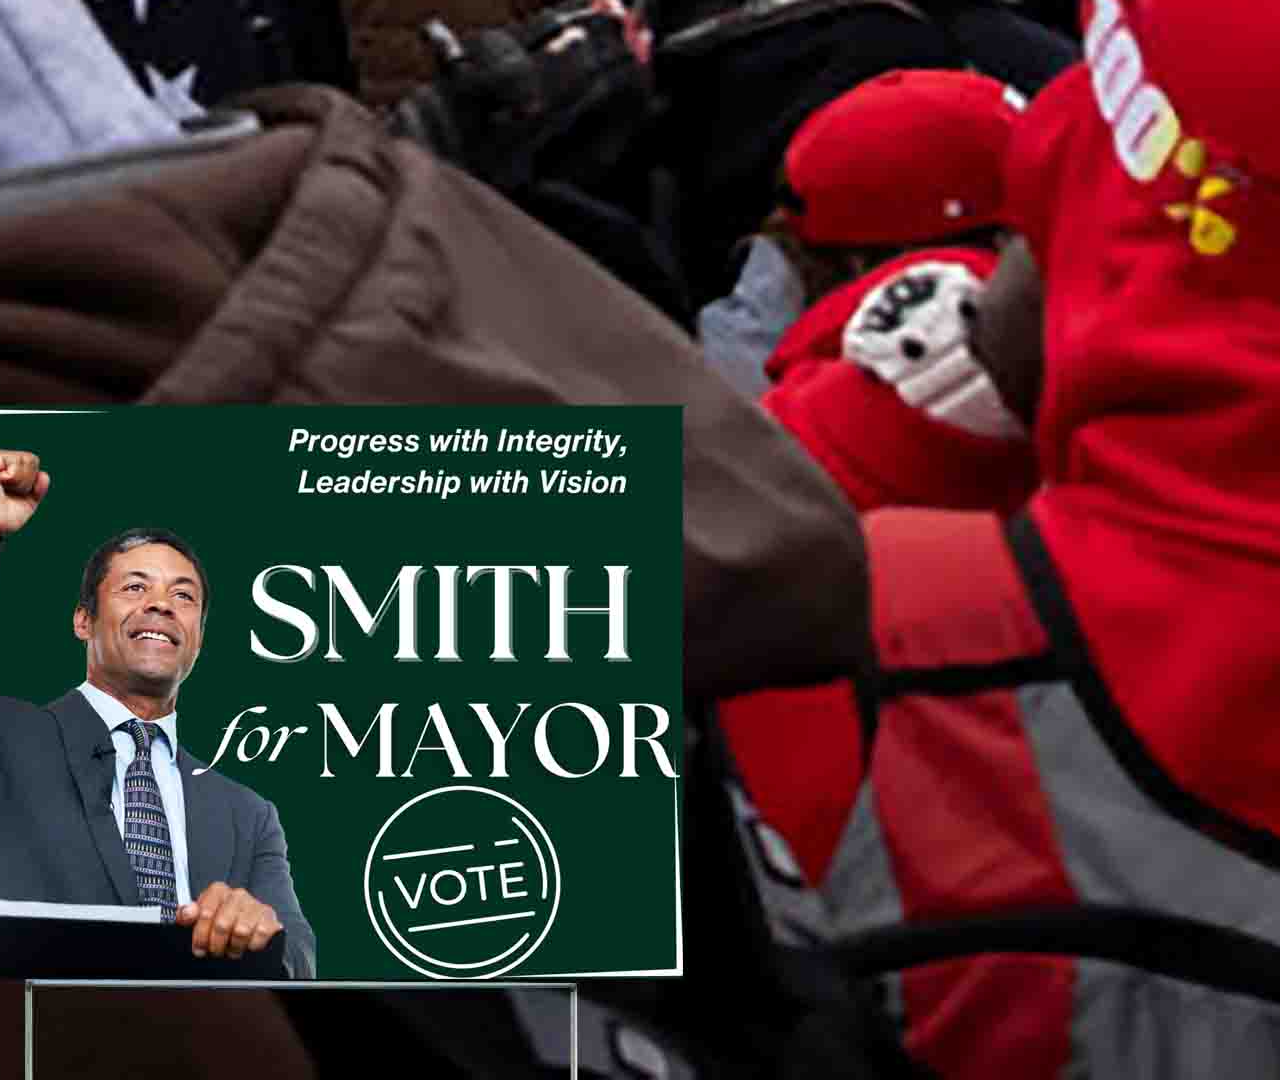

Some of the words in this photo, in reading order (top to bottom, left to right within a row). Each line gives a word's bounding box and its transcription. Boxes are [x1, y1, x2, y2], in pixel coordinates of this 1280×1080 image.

[288, 428, 420, 459] Progress
[429, 428, 489, 452] with
[497, 428, 628, 459] Integrity,
[298, 469, 461, 500] Leadership
[470, 470, 529, 494] with
[540, 469, 627, 494] Vision
[250, 564, 632, 663] SMITH
[192, 706, 308, 775] for
[317, 702, 681, 779] MAYOR
[394, 862, 528, 910] VOTE
